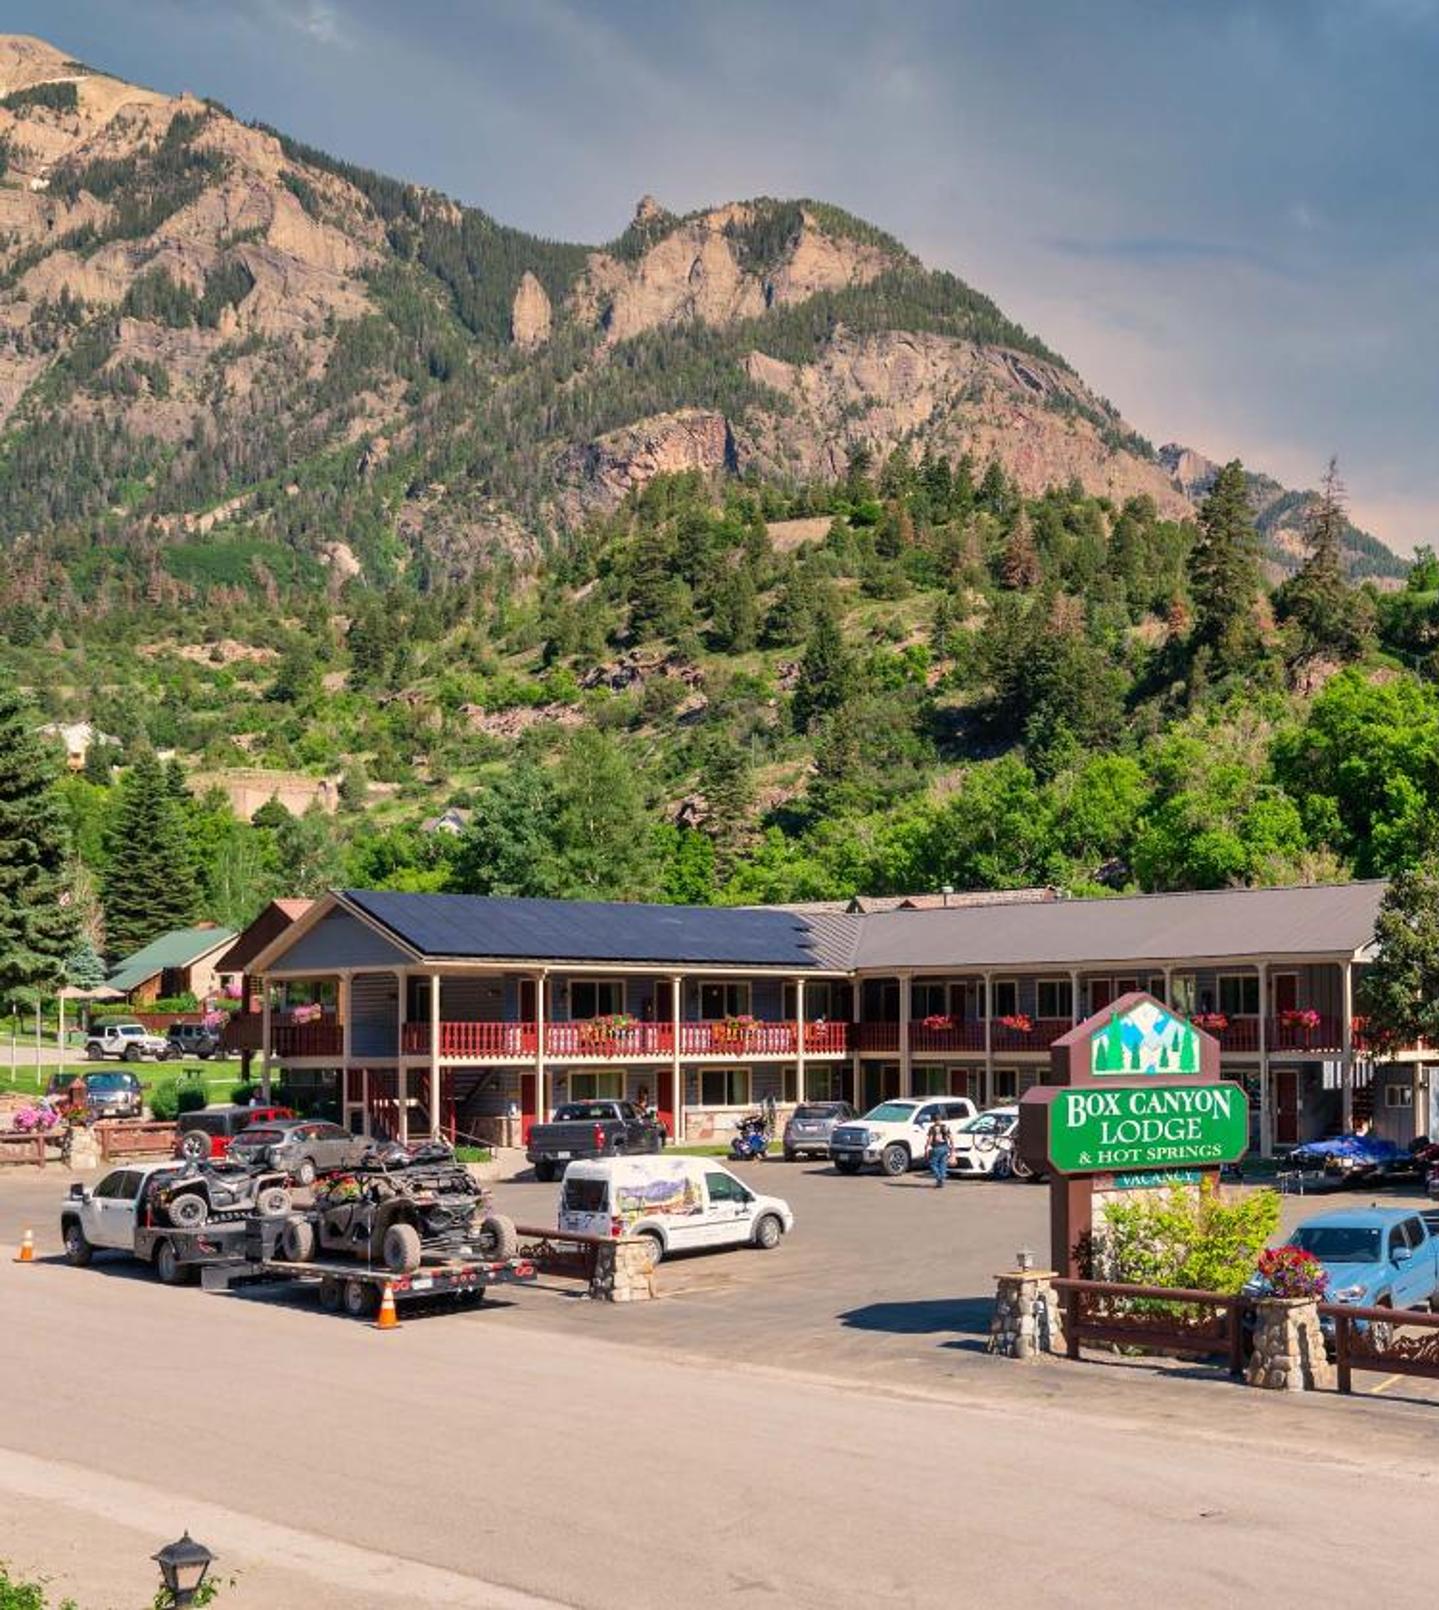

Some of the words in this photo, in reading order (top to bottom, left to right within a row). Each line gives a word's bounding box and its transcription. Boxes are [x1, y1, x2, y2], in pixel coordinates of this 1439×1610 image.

[1067, 1094, 1123, 1127] BOX
[1129, 1089, 1231, 1119] CANYON
[1100, 1117, 1202, 1145] LODGE
[1079, 1152, 1092, 1165] &
[1098, 1149, 1142, 1163] HOT
[1146, 1144, 1222, 1160] SPRINGS
[1123, 1171, 1192, 1185] VACANCY
